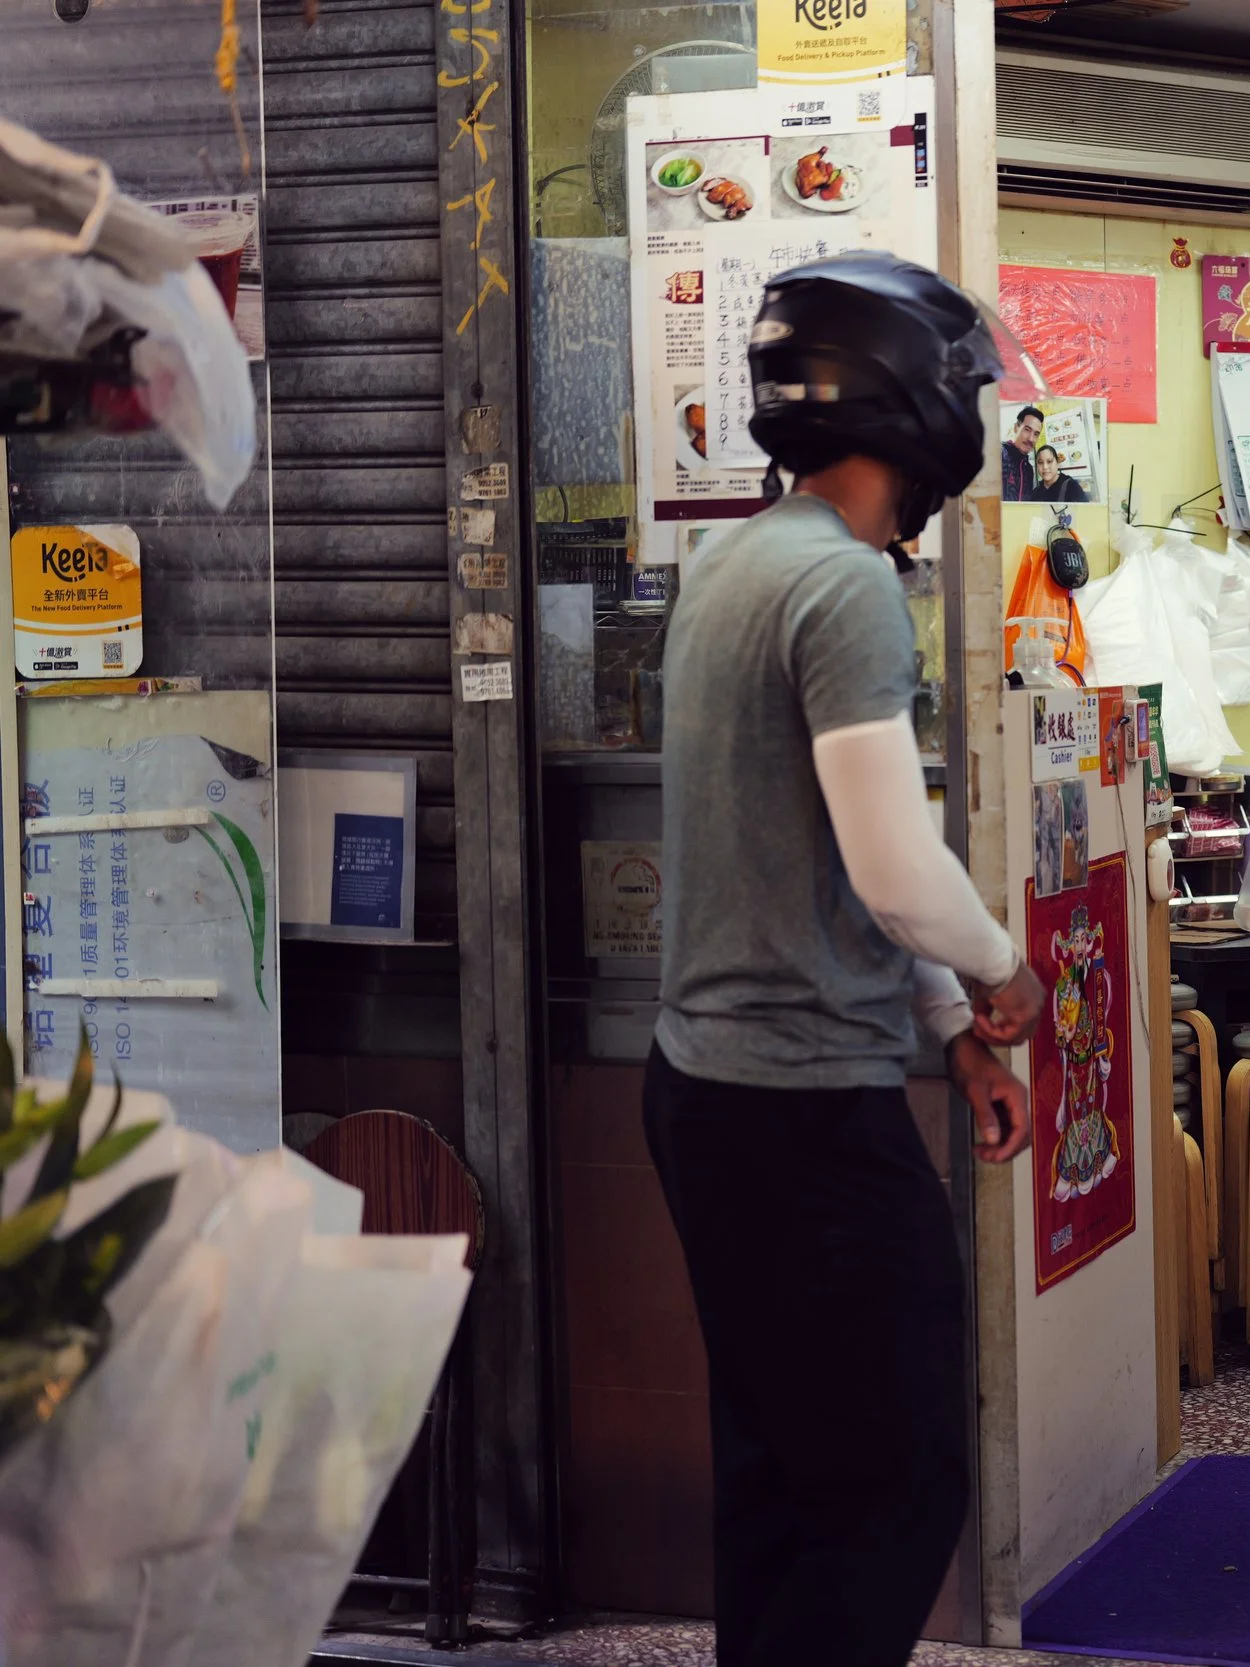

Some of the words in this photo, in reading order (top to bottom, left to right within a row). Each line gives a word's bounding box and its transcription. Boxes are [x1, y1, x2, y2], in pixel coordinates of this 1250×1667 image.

[778, 54, 794, 62] Food
[795, 52, 823, 61] Delivery
[831, 50, 854, 59] Pickup
[855, 49, 886, 57] Platform
[719, 315, 729, 328] 3
[717, 332, 730, 347] 4
[718, 352, 730, 366] 5
[718, 371, 729, 387] 6
[719, 413, 729, 432] 8
[719, 433, 728, 451] 9
[41, 543, 109, 582] KeeTa
[43, 588, 109, 602] 全新外賣平台
[43, 604, 56, 612] New
[71, 604, 96, 612] Delivery
[97, 603, 123, 611] Platform
[1050, 751, 1073, 765] Cashier
[115, 1022, 132, 1061] ISO
